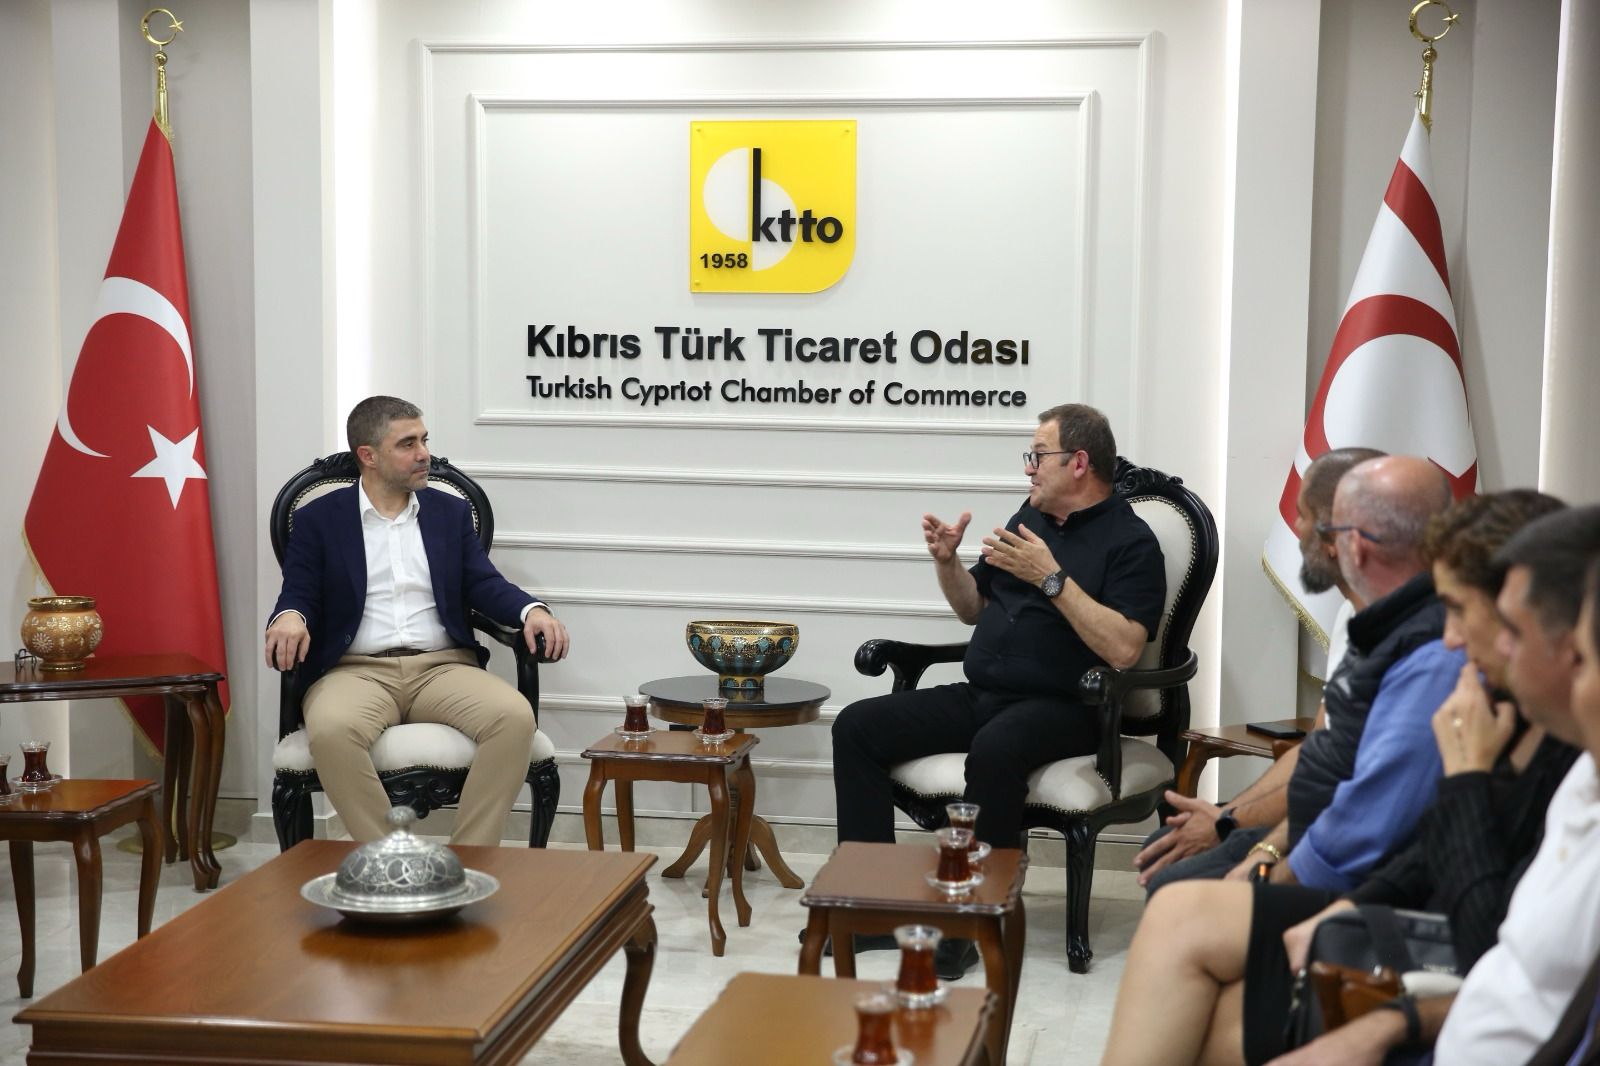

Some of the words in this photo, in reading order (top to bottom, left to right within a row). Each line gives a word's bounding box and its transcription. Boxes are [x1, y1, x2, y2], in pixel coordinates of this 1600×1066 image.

[752, 147, 844, 244] ktto
[700, 253, 748, 269] 1958
[527, 324, 642, 360] Kıbrıs
[654, 326, 746, 362] Türk
[757, 328, 898, 365] Ticaret
[910, 329, 1029, 366] Odası
[526, 375, 612, 400] Turkish
[620, 376, 712, 407] Cypriot
[720, 379, 842, 404] Chamber
[848, 380, 876, 405] of
[883, 381, 1027, 407] Commerce
